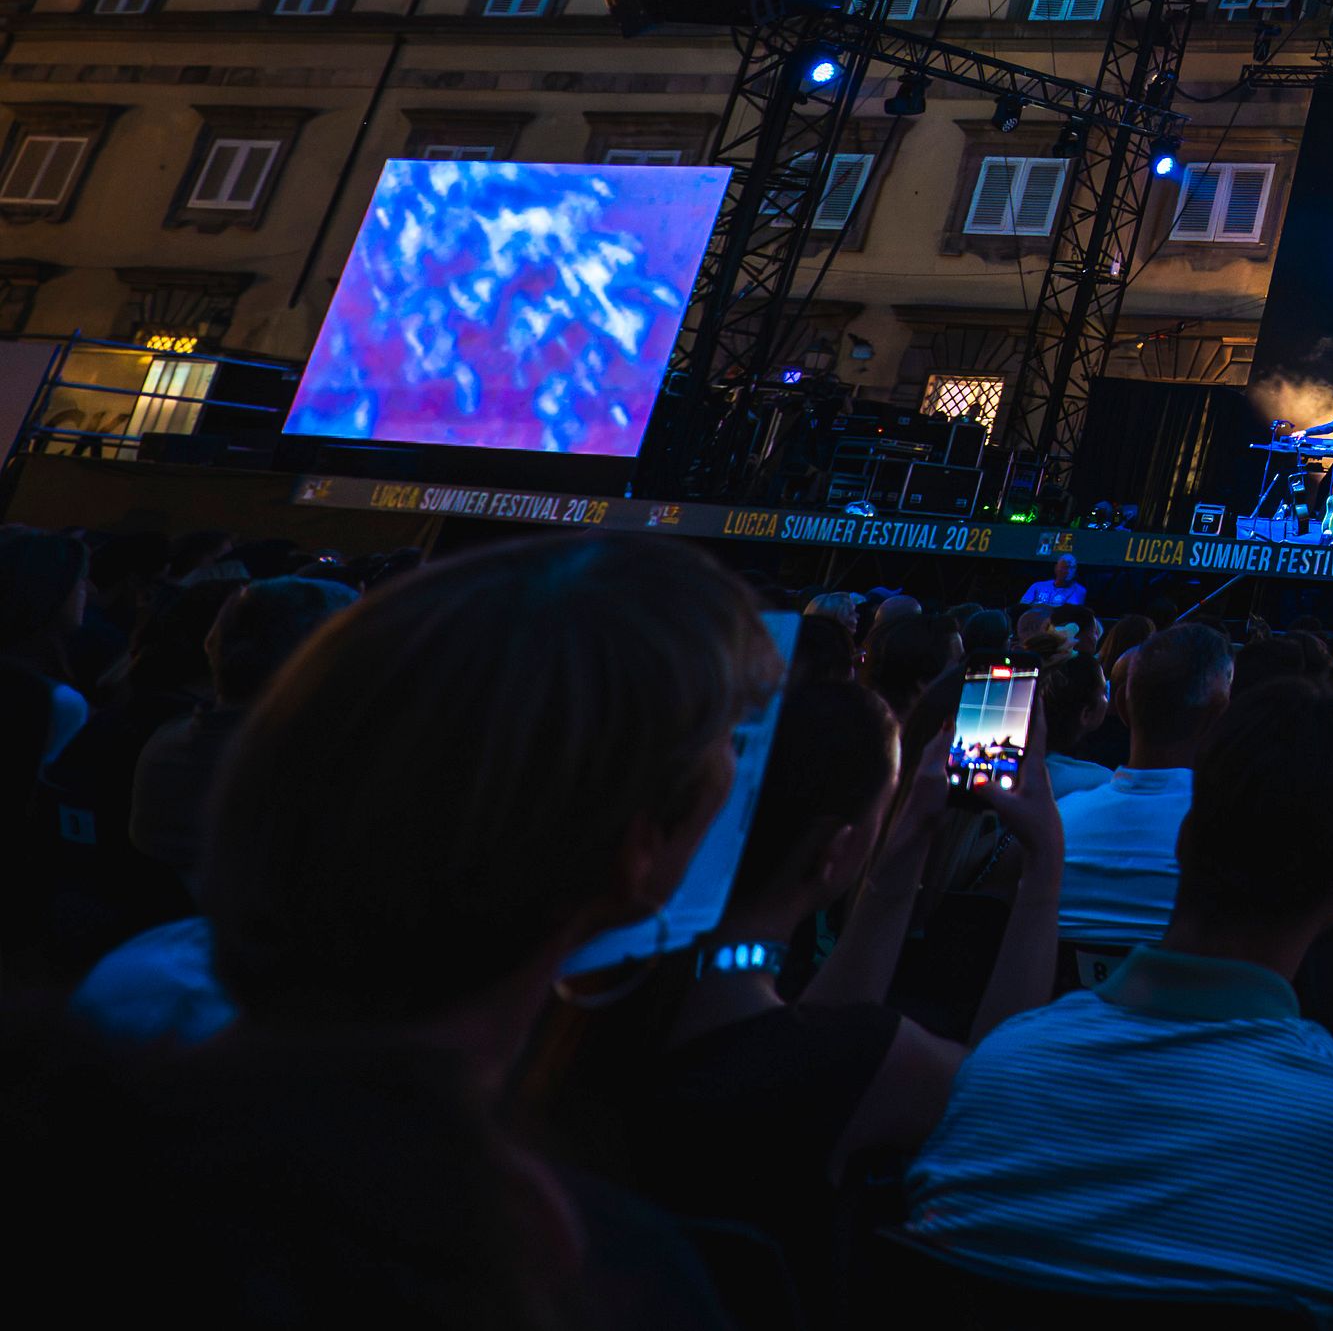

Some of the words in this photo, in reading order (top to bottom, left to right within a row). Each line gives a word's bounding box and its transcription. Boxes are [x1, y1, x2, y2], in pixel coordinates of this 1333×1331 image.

[489, 493, 561, 520] FESTIVAL
[723, 510, 778, 538] LUCCA
[780, 514, 858, 544] SUMMER
[858, 519, 939, 549] FESTIVAL
[942, 525, 993, 552] 2026
[1125, 537, 1185, 566] LUCCA
[1189, 541, 1273, 572] SUMMER
